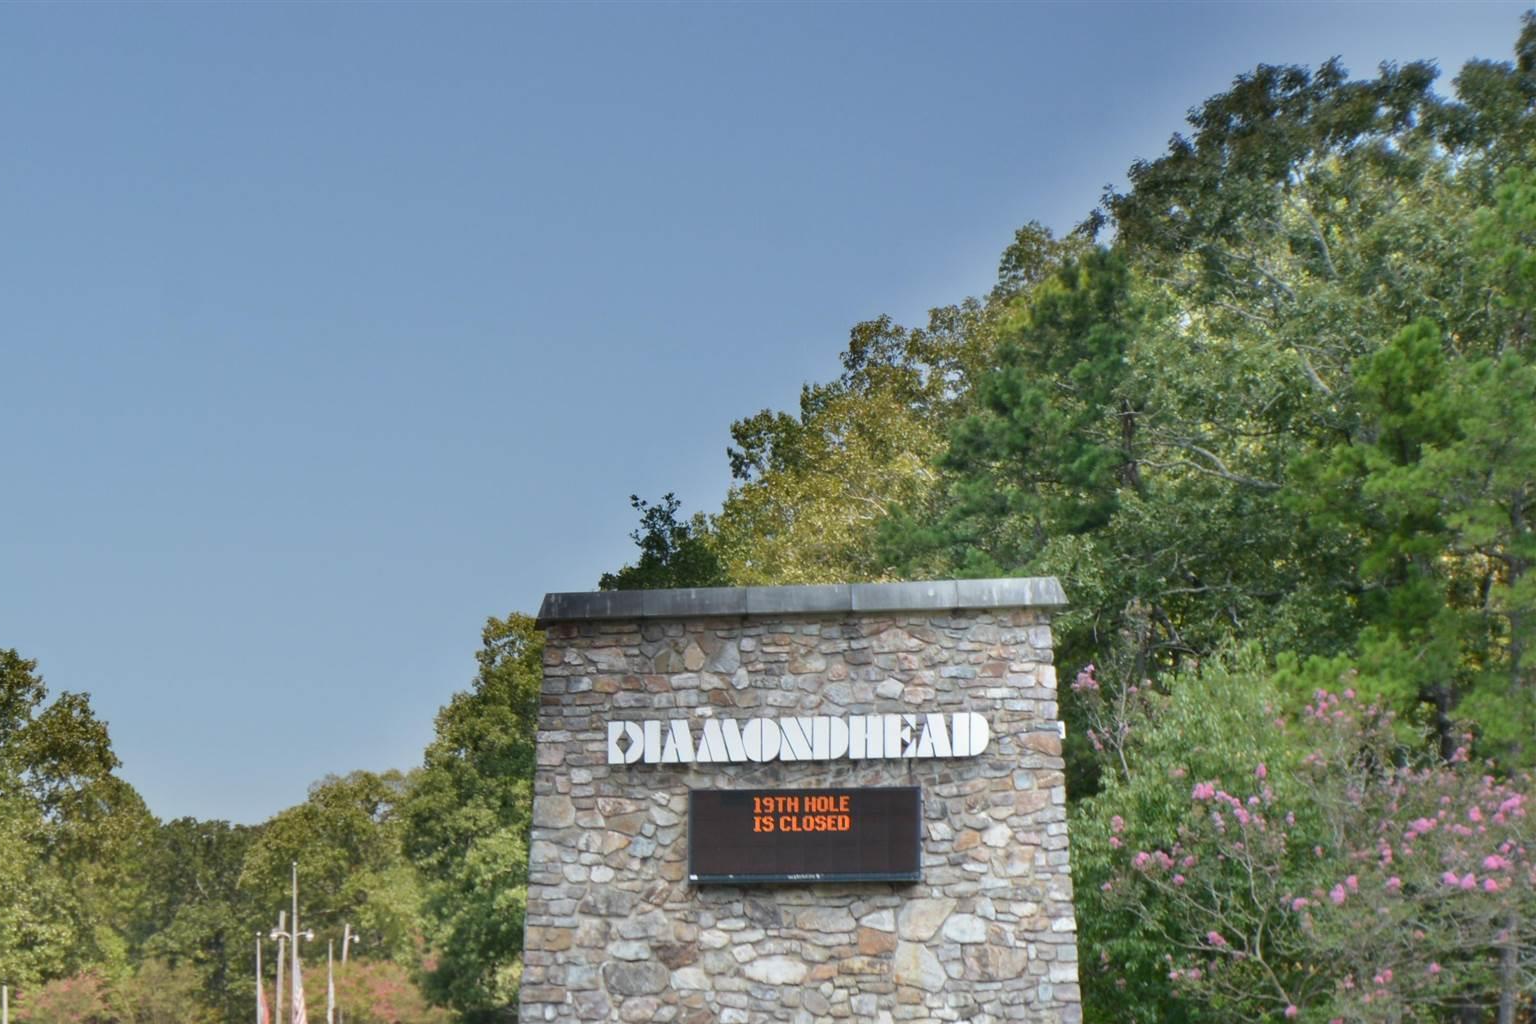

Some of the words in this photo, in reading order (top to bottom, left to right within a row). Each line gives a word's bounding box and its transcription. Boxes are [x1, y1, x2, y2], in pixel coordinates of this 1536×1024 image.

[608, 712, 989, 764] DIAMONDHEAD
[753, 796, 800, 813] 19TH
[804, 795, 850, 812] HOLE
[753, 815, 775, 832] IS
[779, 815, 850, 832] CLOSED
